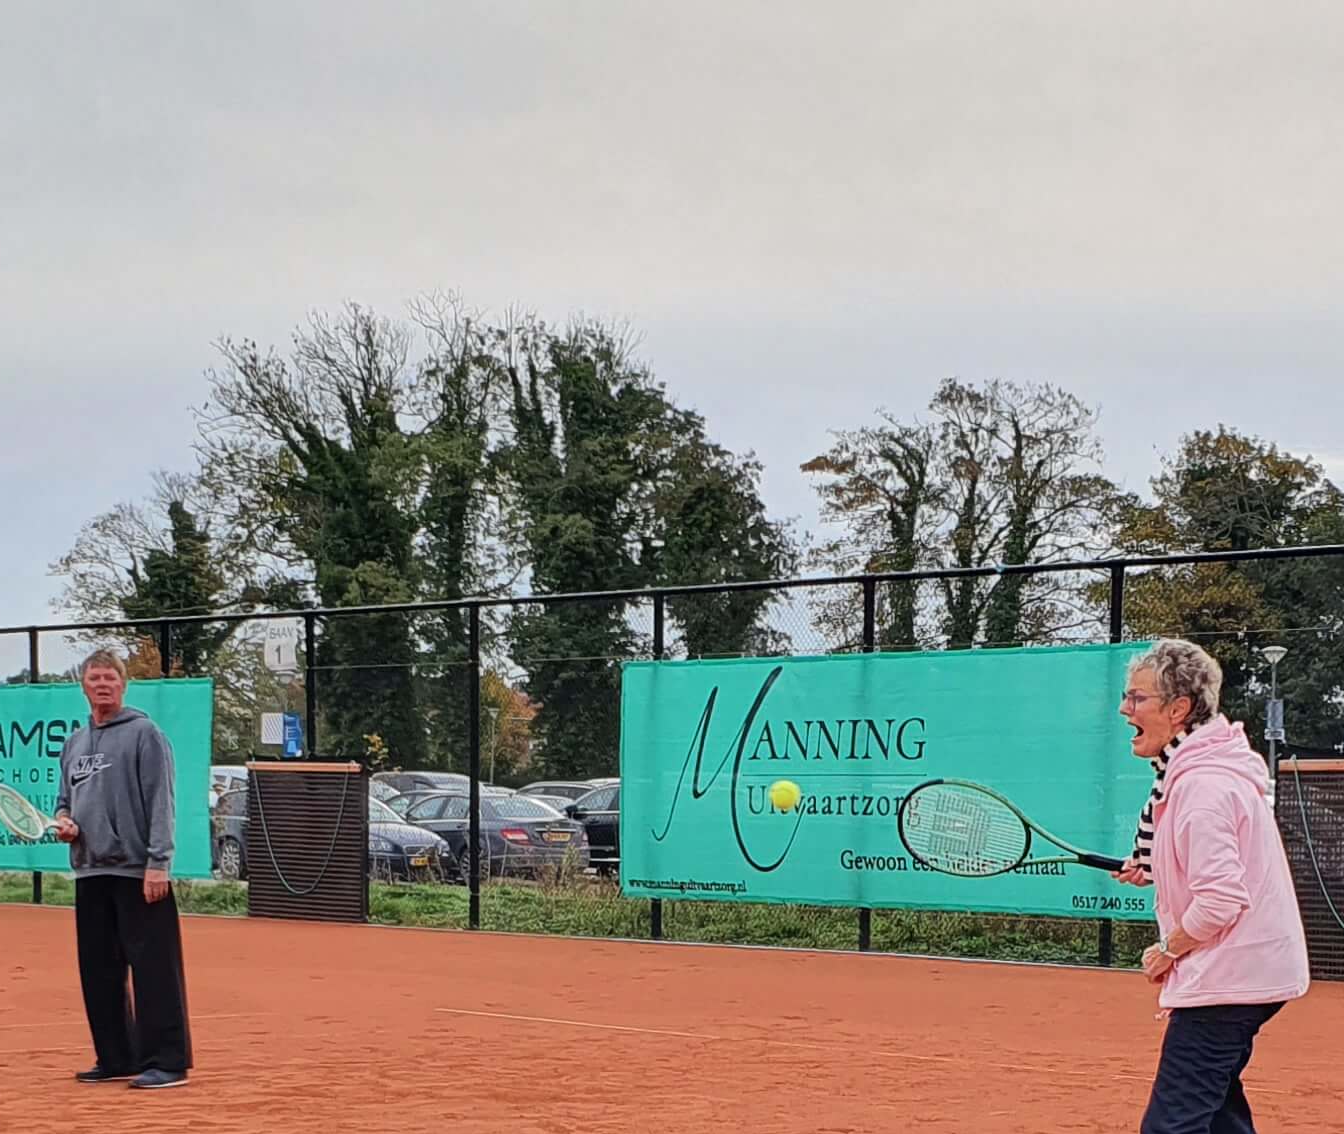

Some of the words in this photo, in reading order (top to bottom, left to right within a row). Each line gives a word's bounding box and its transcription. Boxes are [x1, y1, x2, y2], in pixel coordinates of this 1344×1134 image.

[274, 644, 282, 665] 1
[746, 785, 922, 828] Uvaartzorg
[840, 850, 907, 871] Gewoon
[1072, 895, 1098, 910] 0517
[1100, 896, 1121, 910] 240
[1124, 897, 1145, 912] 555
